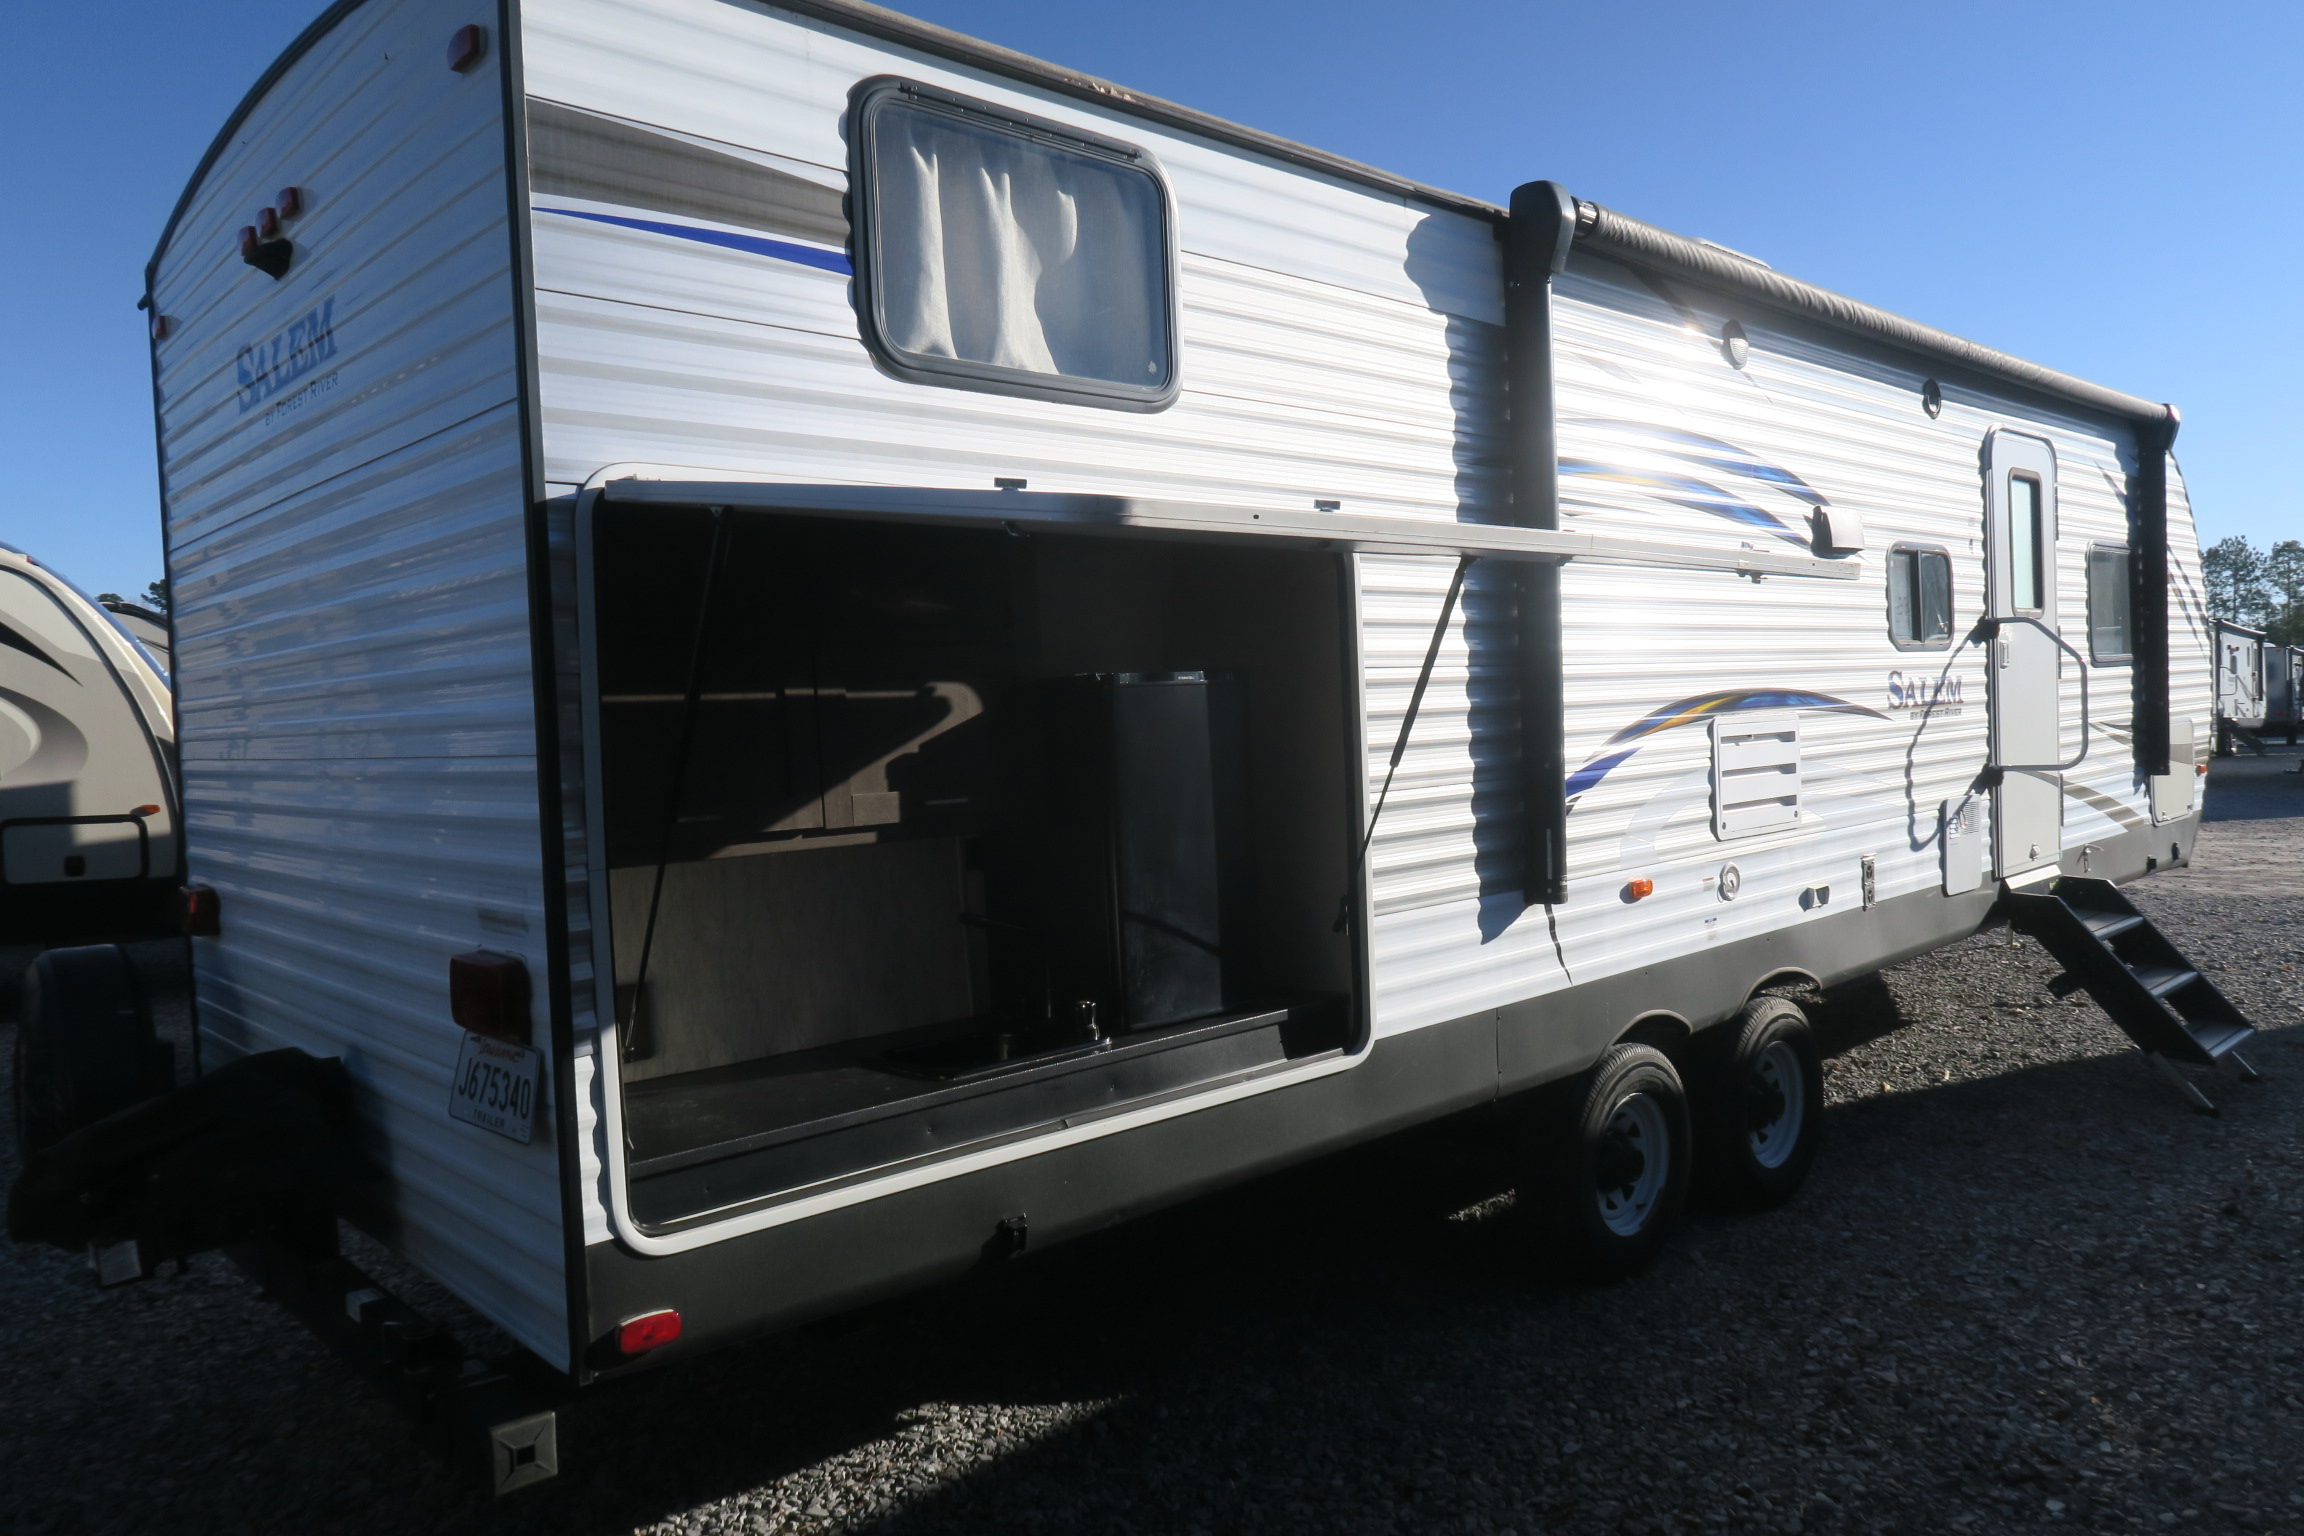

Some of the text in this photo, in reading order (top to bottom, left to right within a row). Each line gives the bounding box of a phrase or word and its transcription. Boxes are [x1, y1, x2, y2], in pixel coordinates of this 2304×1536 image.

[236, 295, 338, 416] SALEM
[275, 391, 308, 416] FOREST
[310, 372, 338, 398] RIVER
[1887, 670, 1964, 709] SALEM
[1945, 707, 1962, 716] RIVER
[458, 1057, 531, 1120] J675340
[473, 1109, 505, 1129] TRAILER
